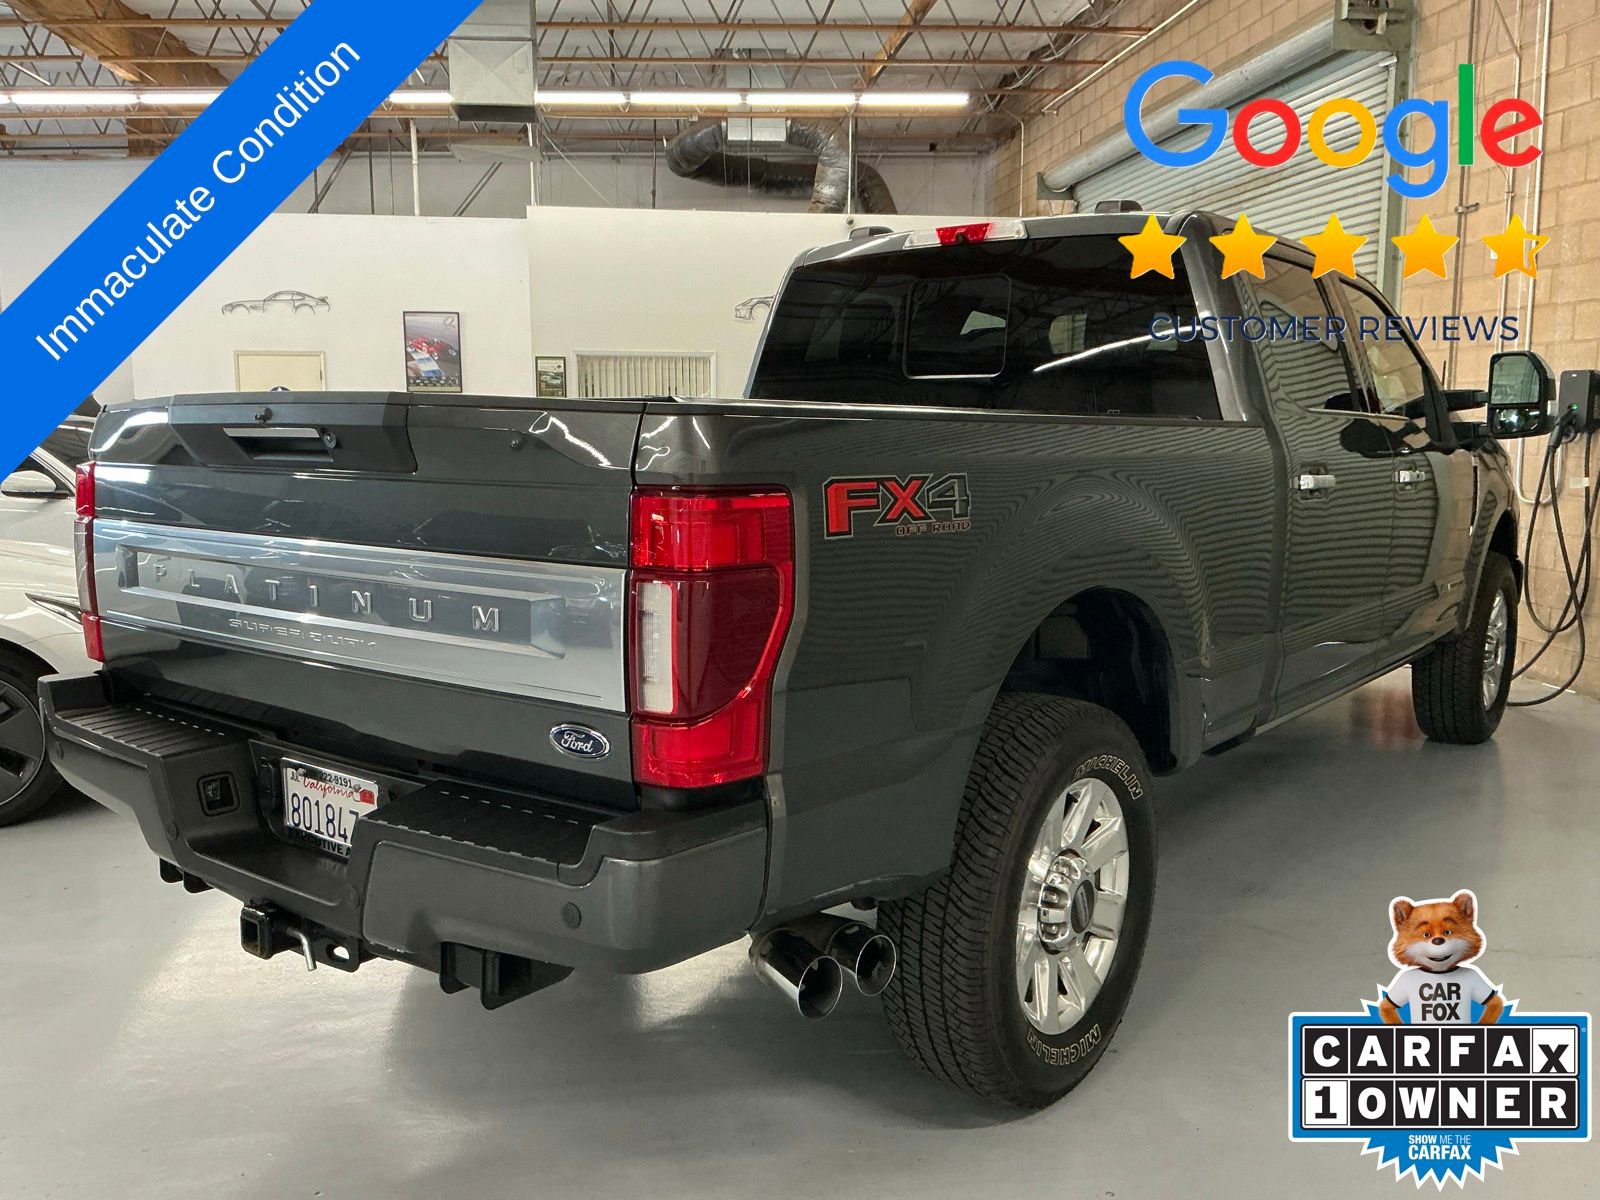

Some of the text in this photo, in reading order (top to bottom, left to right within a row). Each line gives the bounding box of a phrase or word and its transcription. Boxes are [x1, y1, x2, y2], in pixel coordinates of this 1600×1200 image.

[822, 472, 972, 540] FX4
[895, 520, 972, 537] OFF ROAD
[152, 564, 500, 633] PLATINUM
[560, 730, 594, 753] Ford
[1073, 754, 1144, 800] MICHELIN
[1026, 1023, 1102, 1066] MICHELIN
